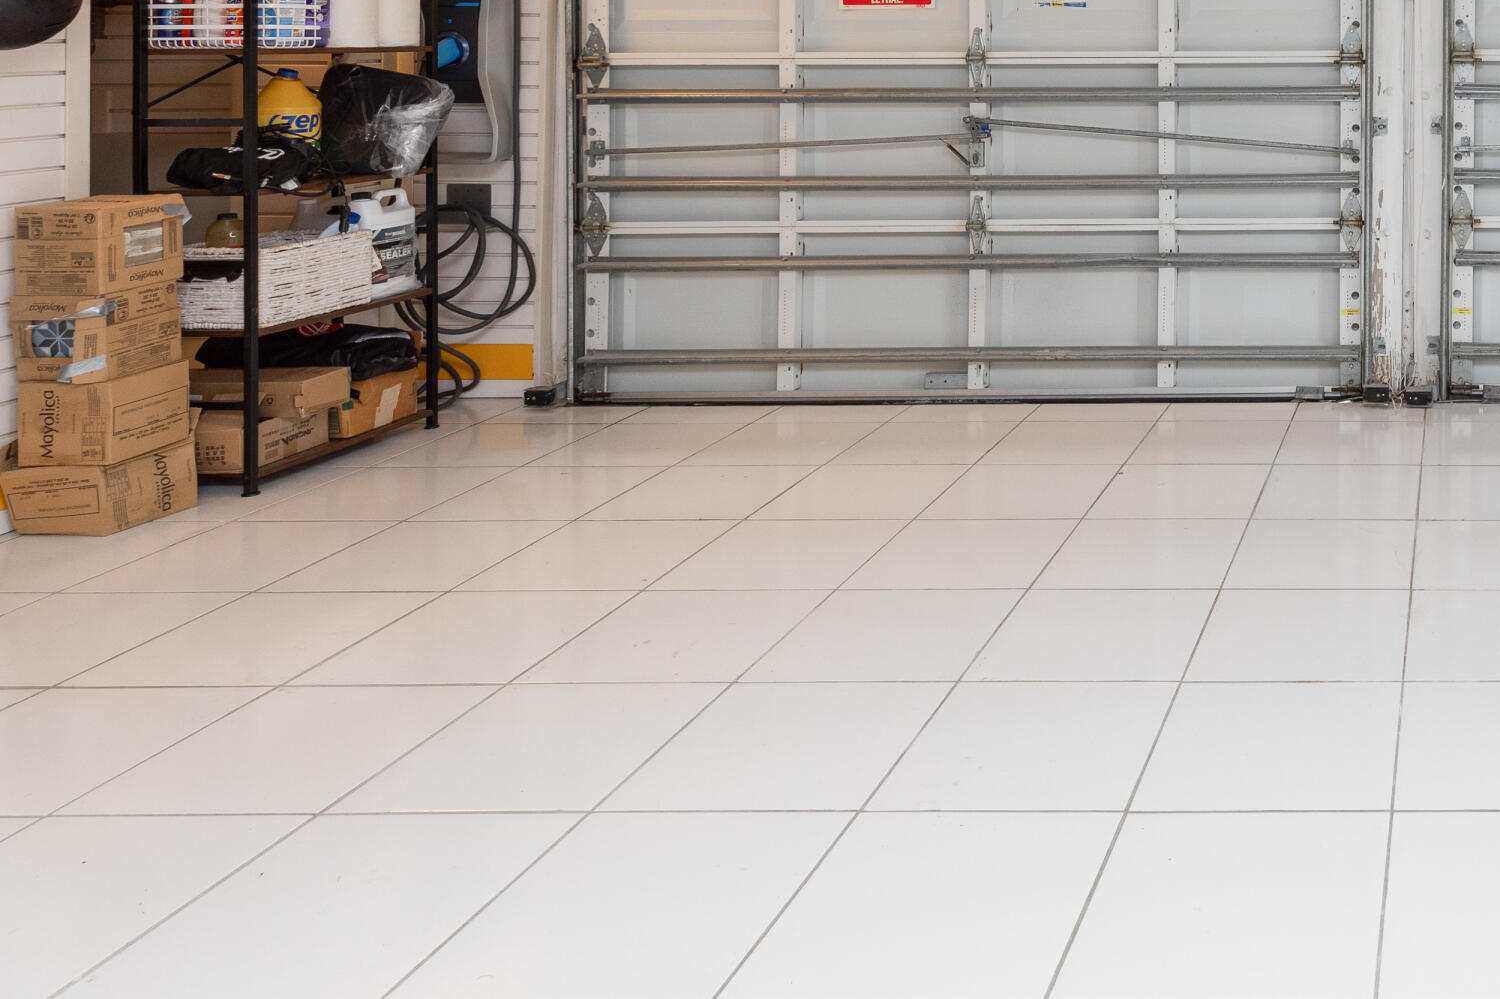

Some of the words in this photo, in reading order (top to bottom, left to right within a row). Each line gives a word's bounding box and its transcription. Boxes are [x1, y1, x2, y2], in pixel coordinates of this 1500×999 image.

[380, 244, 412, 261] SEALER
[129, 269, 164, 281] Mayolica
[29, 303, 68, 313] Mayolica
[40, 390, 59, 459] Mayolica
[152, 453, 176, 512] Mayolica
